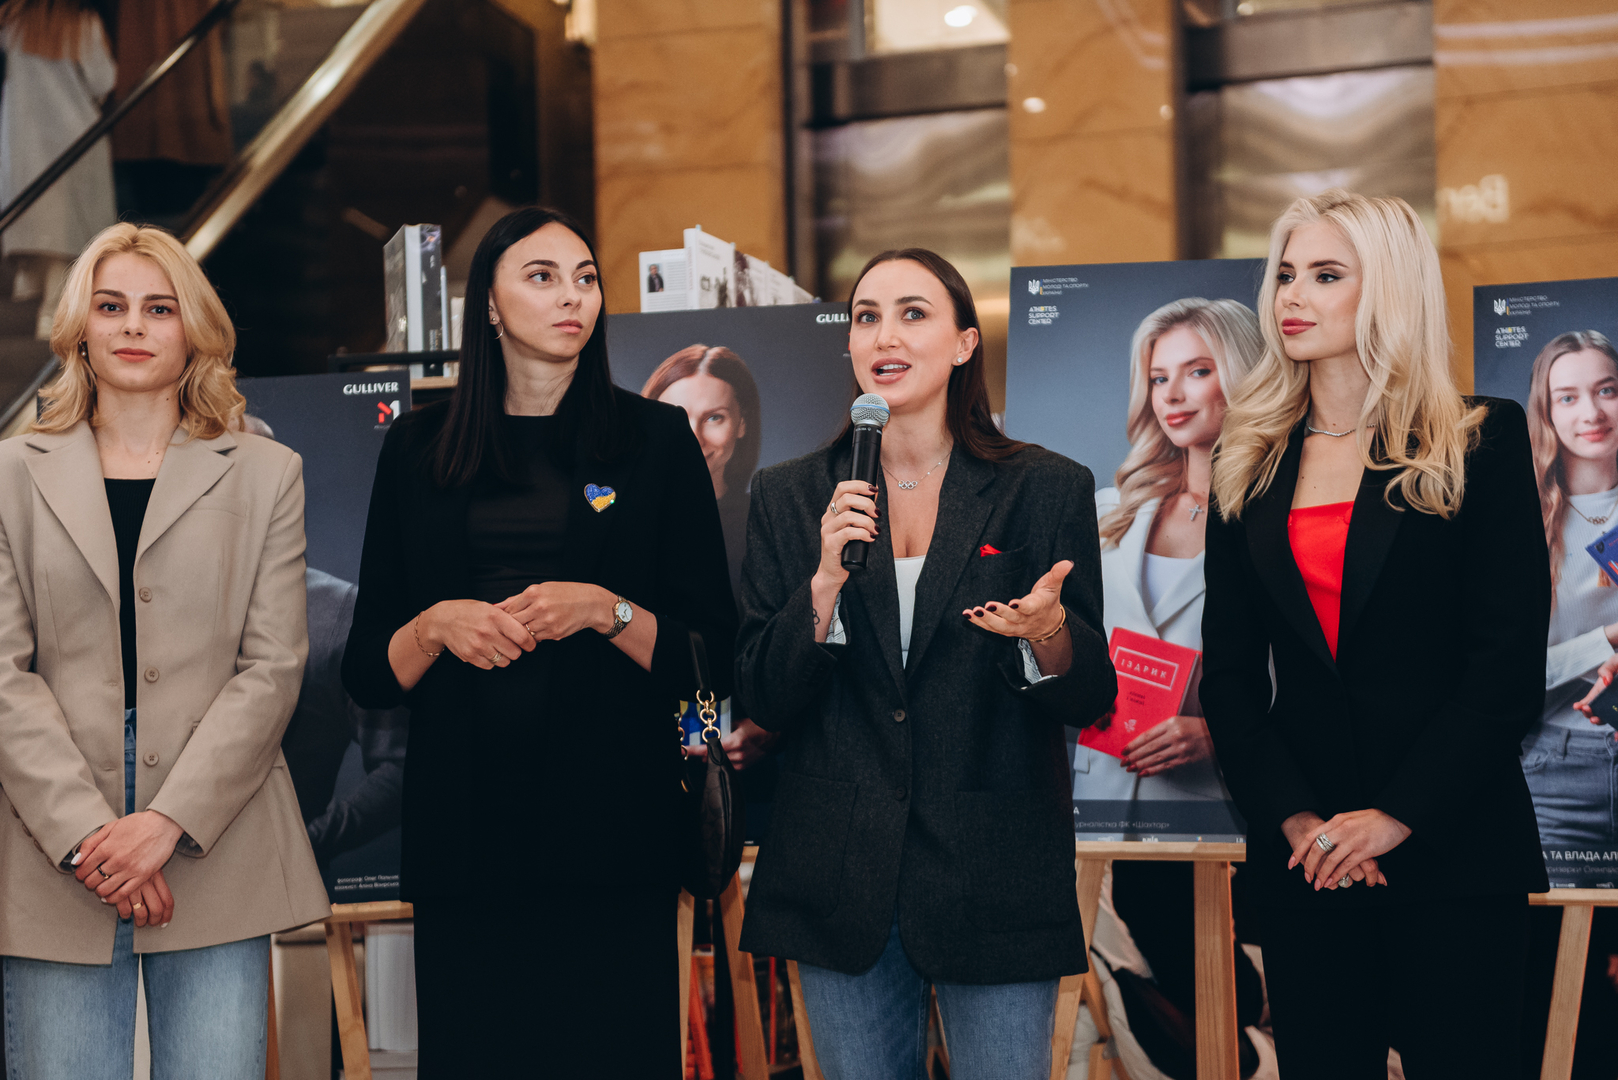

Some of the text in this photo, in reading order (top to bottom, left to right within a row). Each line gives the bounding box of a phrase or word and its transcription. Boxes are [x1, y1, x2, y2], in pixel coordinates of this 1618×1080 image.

[816, 313, 850, 323] GULLI
[1495, 333, 1529, 341] SUPPORT
[1495, 340, 1521, 348] CENTER
[343, 382, 399, 395] GULLIVER
[1075, 821, 1117, 829] урналістка
[1119, 820, 1130, 829] ФК
[1550, 850, 1563, 861] ТА
[1565, 850, 1601, 862] ВЛАДА
[1603, 851, 1618, 861] АЛ
